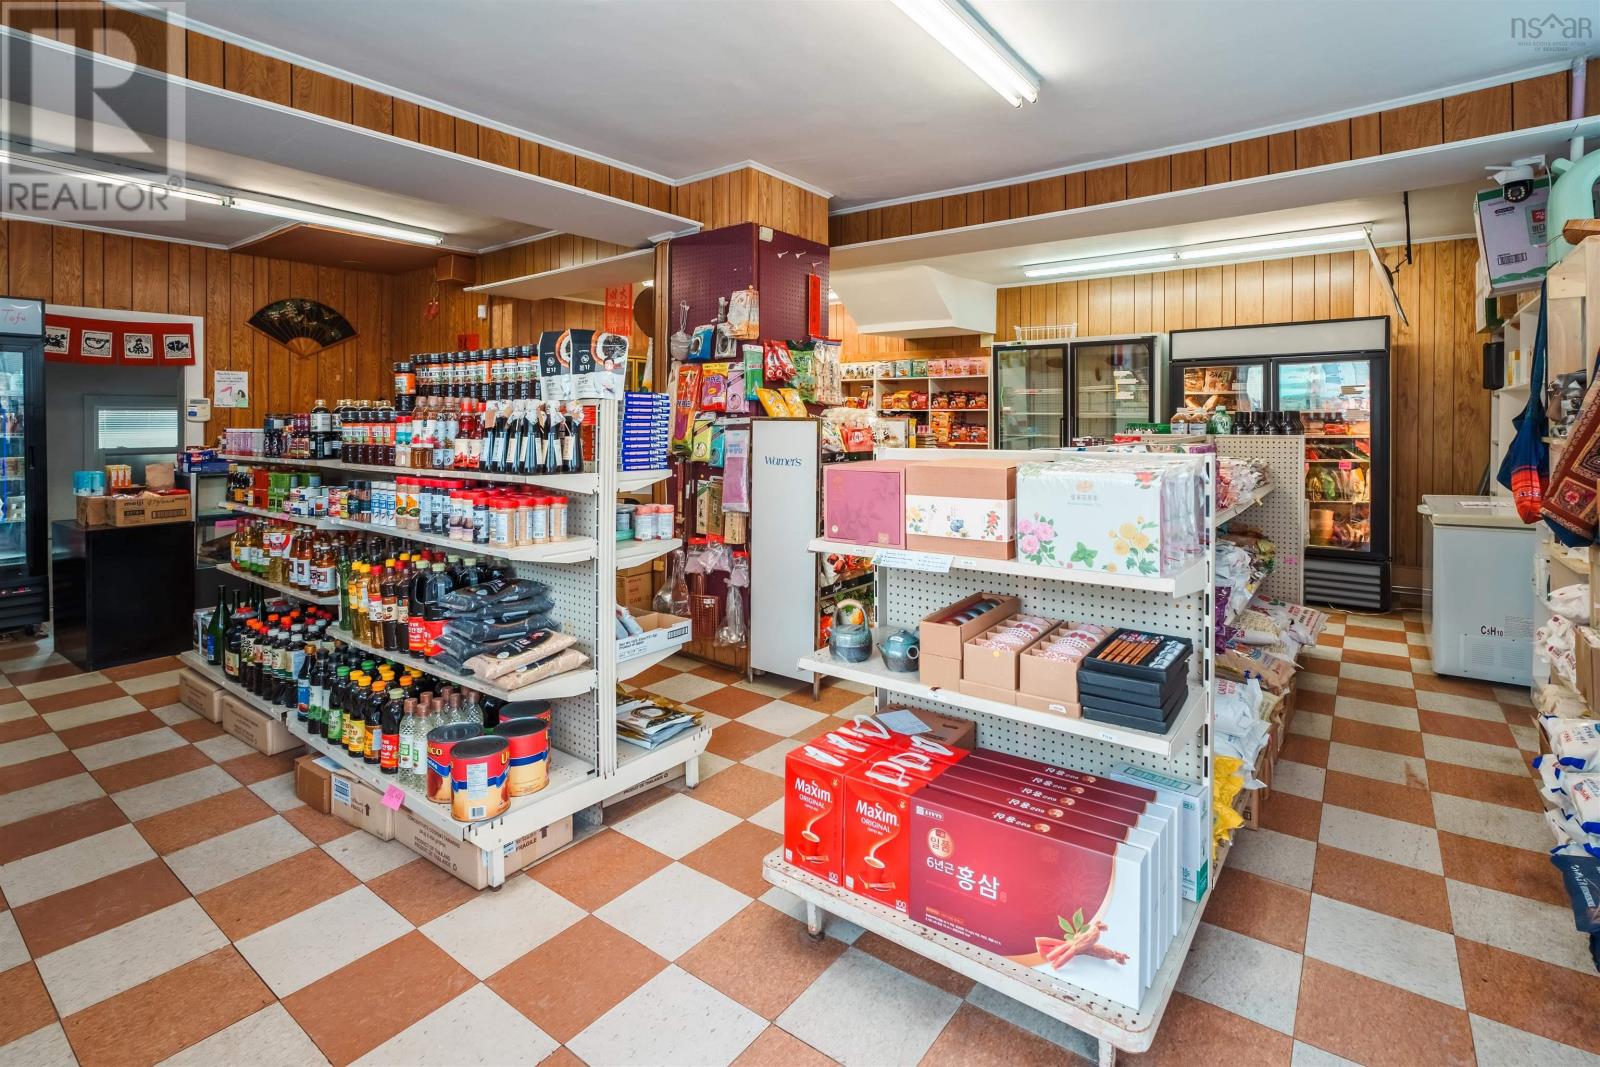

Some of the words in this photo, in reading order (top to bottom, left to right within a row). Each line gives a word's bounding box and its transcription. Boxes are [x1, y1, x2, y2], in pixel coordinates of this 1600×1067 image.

[795, 777, 833, 803] Maxim
[799, 794, 826, 809] ORIGINAL
[856, 799, 899, 827] Maxim
[860, 817, 892, 833] ORIGINAL
[515, 837, 537, 852] FRAGILE
[926, 856, 955, 876] 6년근
[955, 864, 1000, 901] 홍삼
